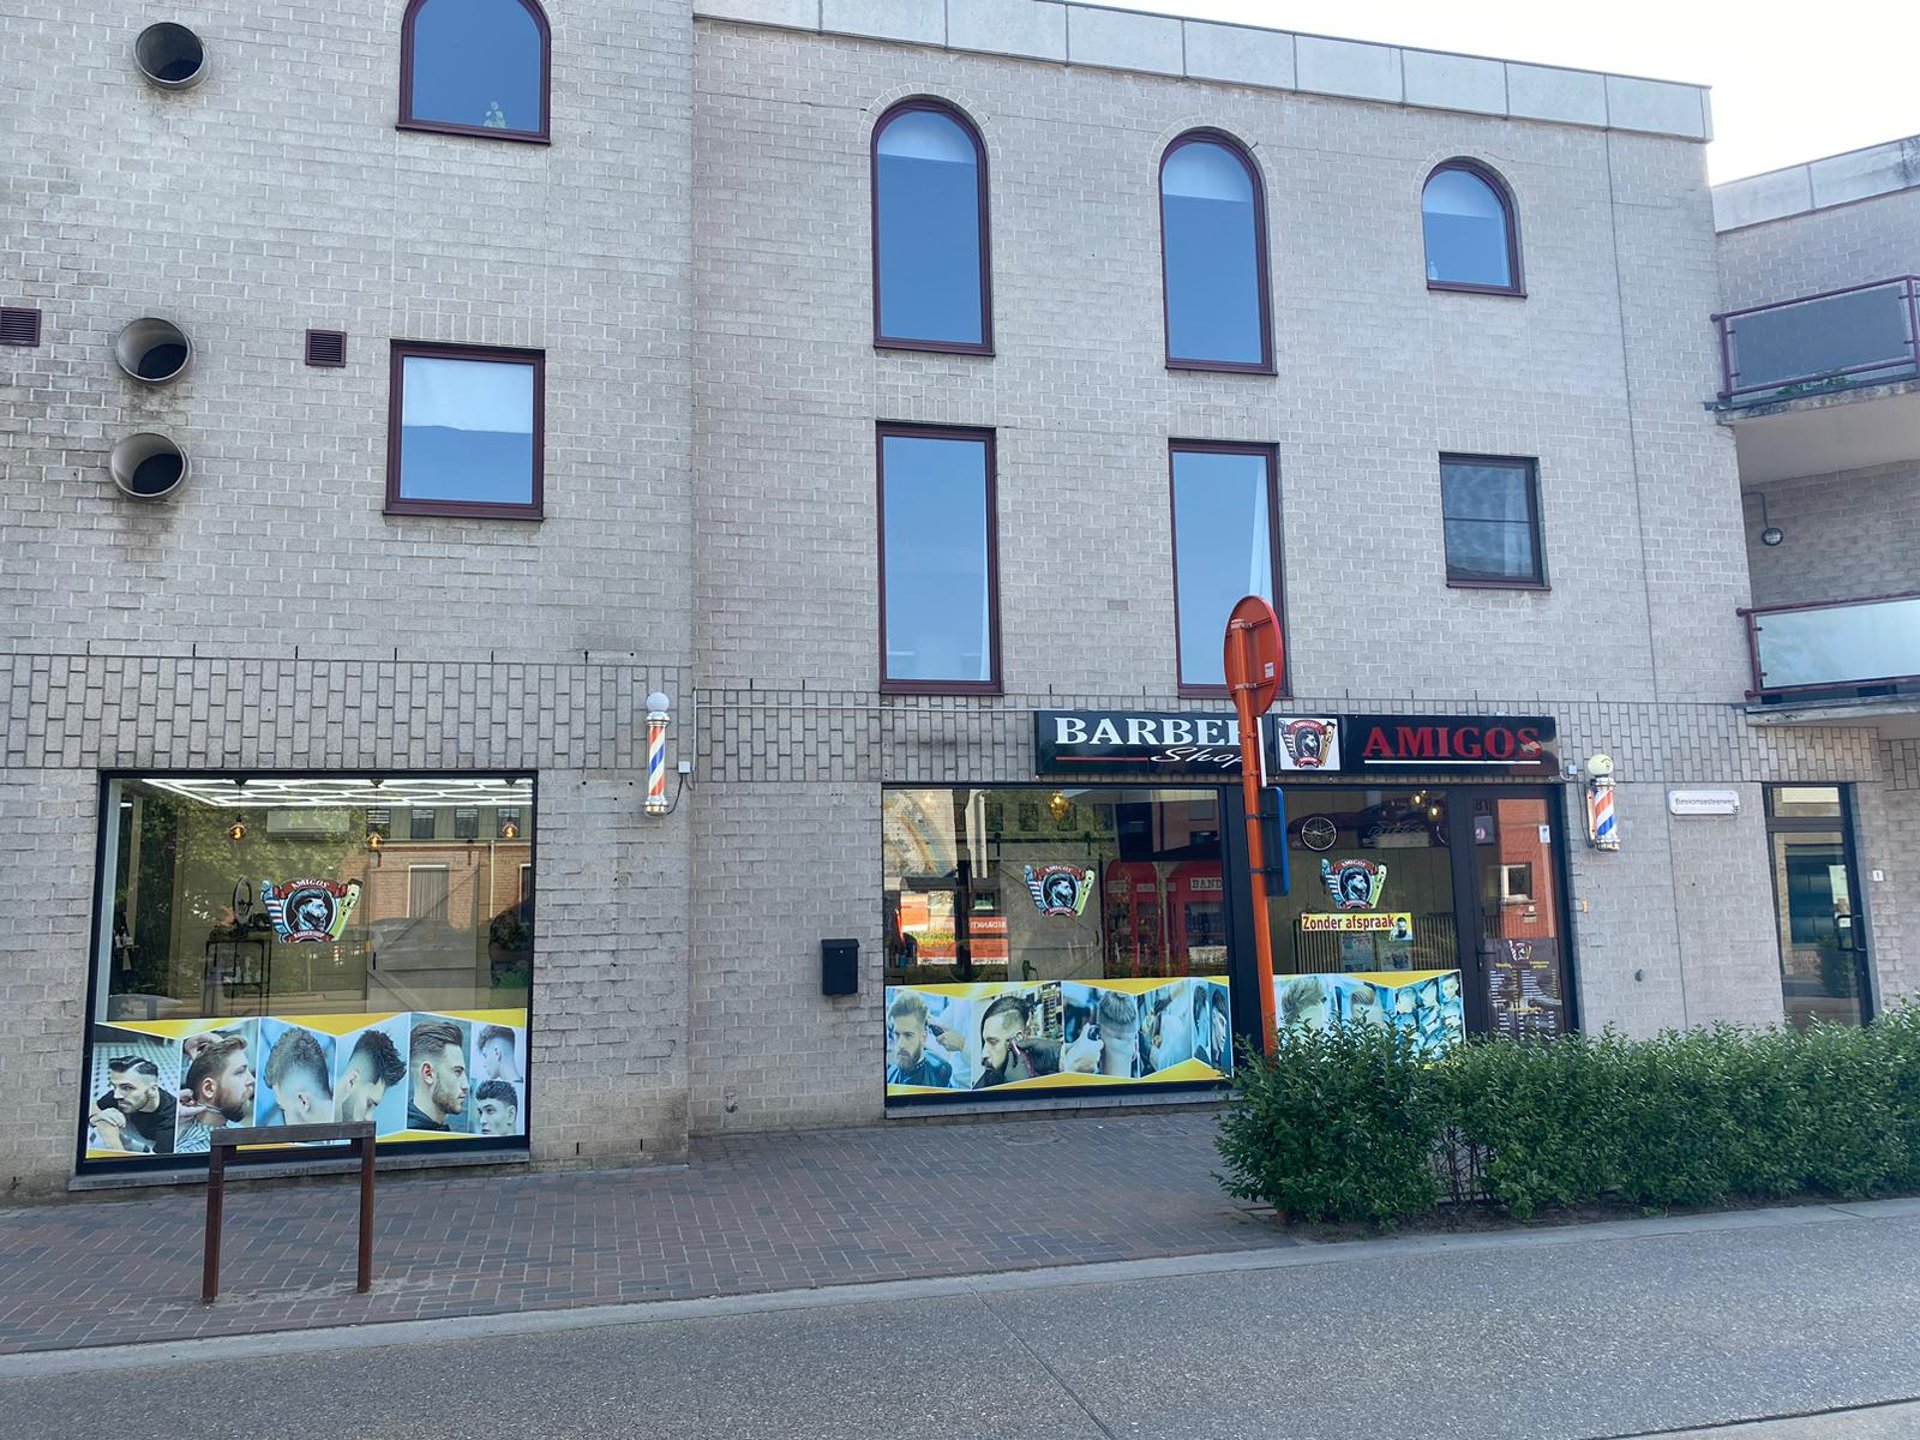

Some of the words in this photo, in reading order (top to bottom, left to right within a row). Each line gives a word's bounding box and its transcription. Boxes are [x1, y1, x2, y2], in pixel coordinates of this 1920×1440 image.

[1362, 726, 1543, 758] AMIGOS
[291, 879, 330, 889] AMIGOS
[1303, 915, 1342, 930] Zonder
[1346, 914, 1395, 931] afspraak
